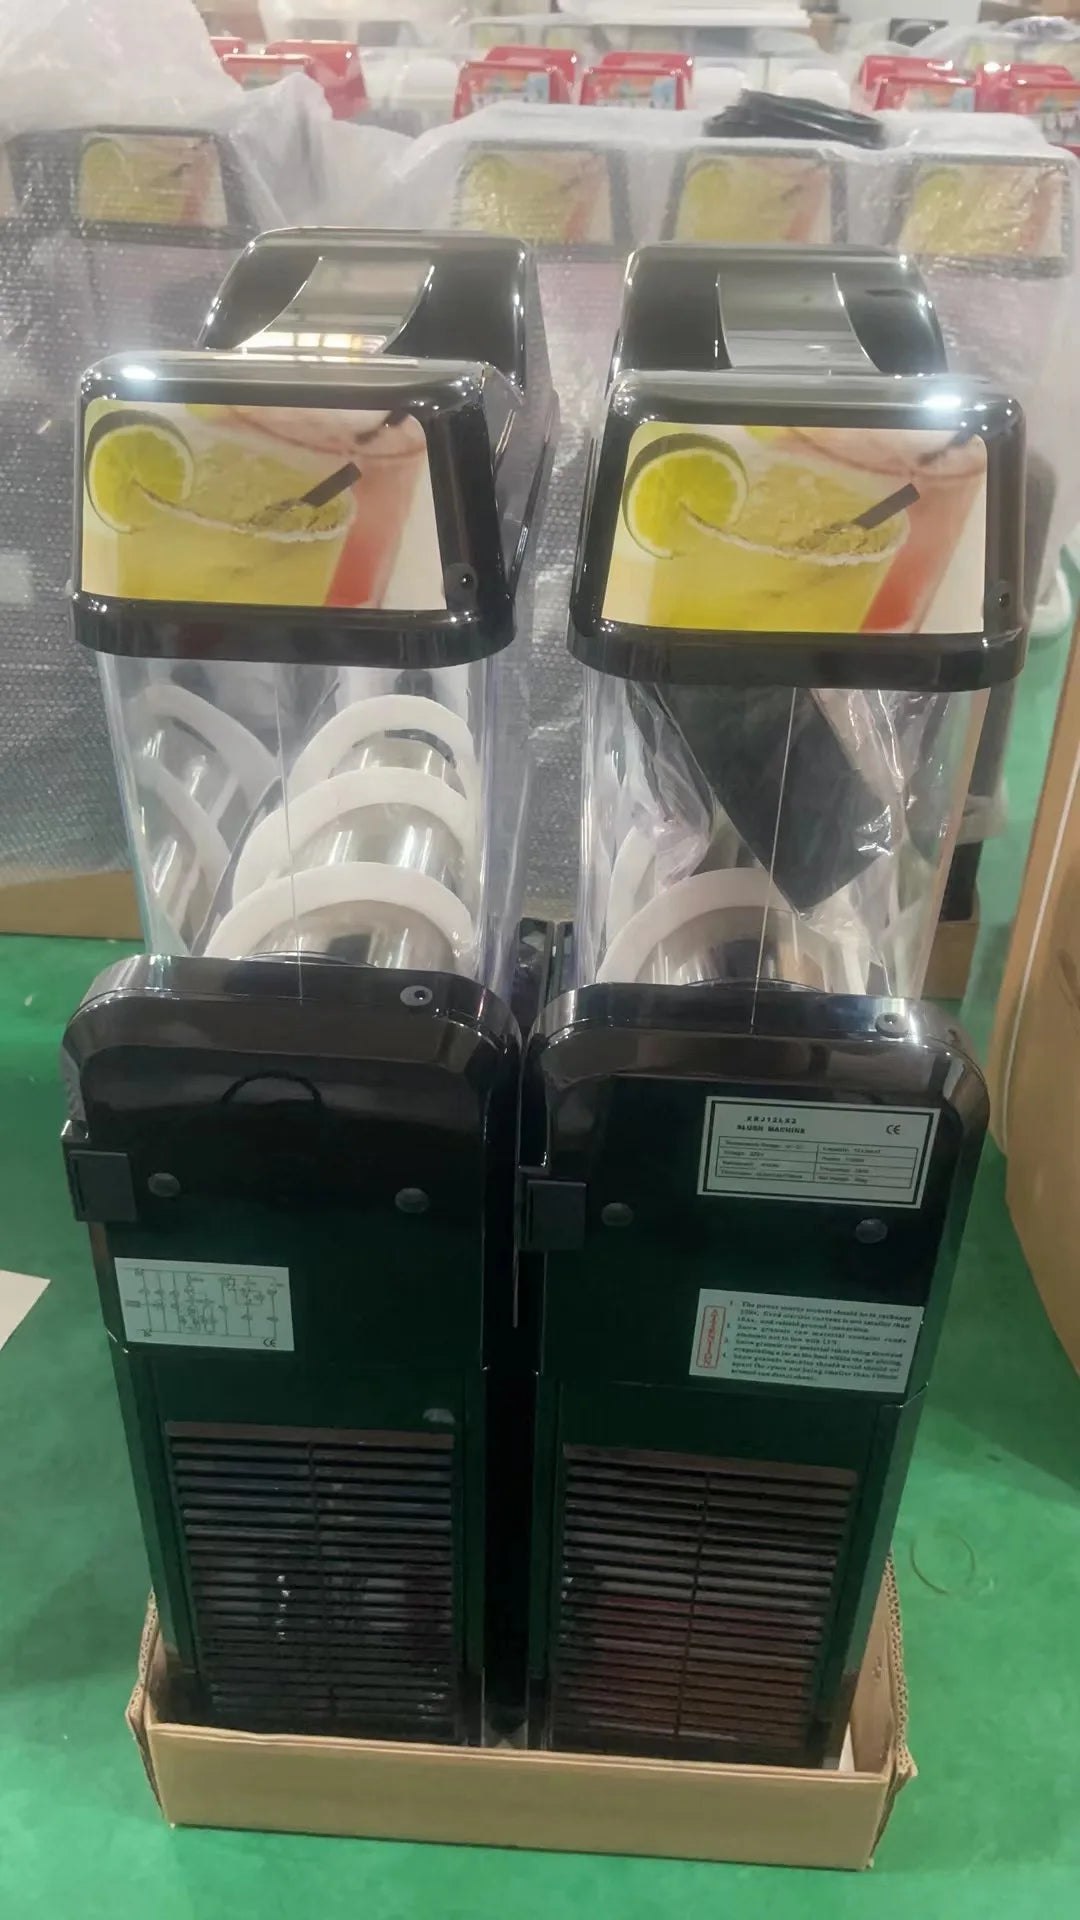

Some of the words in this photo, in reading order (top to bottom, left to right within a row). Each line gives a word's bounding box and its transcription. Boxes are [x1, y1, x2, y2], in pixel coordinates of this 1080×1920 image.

[768, 1126, 806, 1134] MACHINE
[886, 1124, 901, 1135] CE
[263, 1337, 277, 1348] CE
